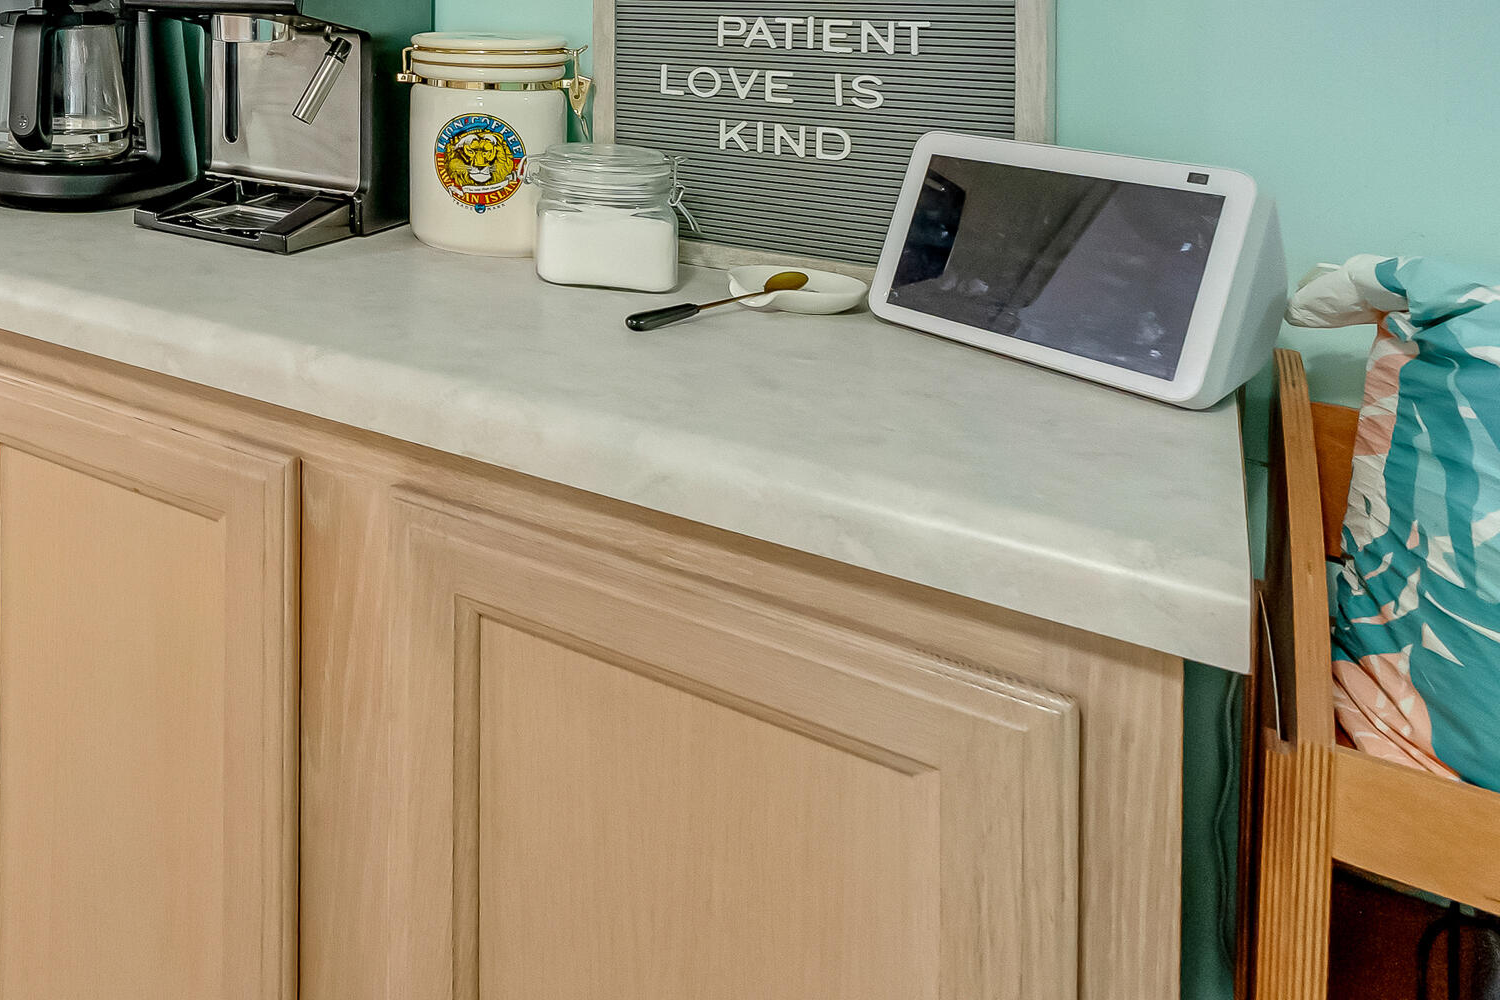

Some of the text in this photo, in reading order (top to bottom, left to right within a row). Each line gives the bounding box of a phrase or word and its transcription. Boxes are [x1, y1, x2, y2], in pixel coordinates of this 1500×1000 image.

[717, 15, 931, 56] PATIENT
[660, 63, 885, 109] LOVE IS
[437, 119, 464, 150] LION
[718, 118, 851, 161] KIND
[437, 157, 480, 204] HAWAN
